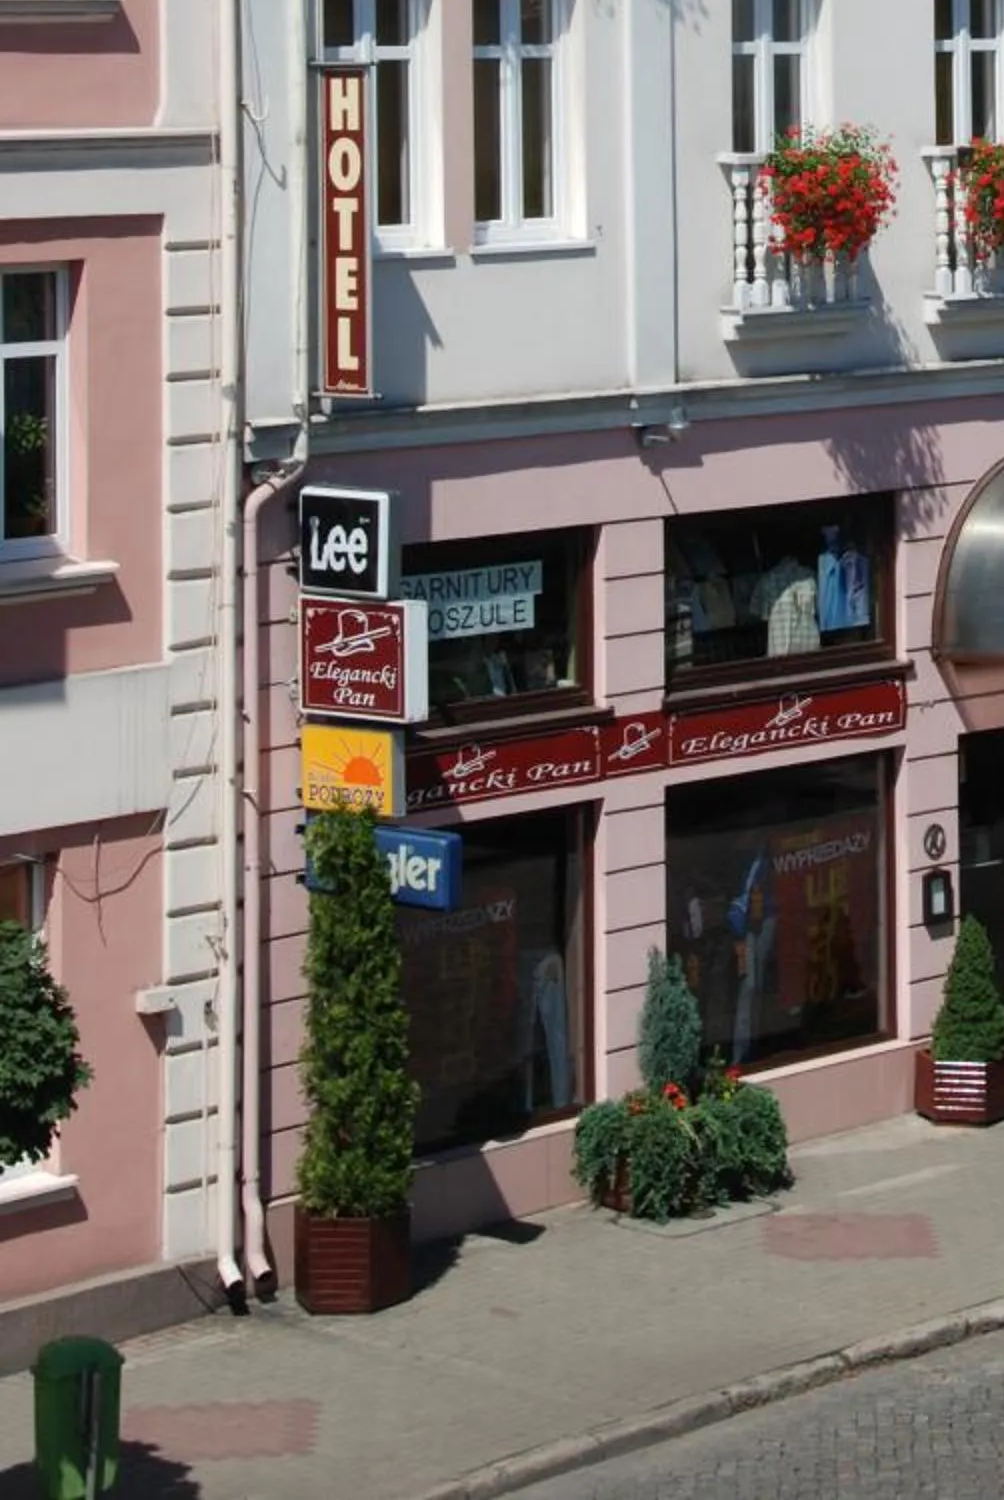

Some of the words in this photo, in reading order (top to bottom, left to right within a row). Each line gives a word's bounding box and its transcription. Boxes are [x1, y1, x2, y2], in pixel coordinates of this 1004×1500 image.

[328, 77, 361, 371] HOTEL
[309, 515, 369, 575] Lee
[400, 565, 535, 601] GARNITURY
[428, 599, 528, 635] OSZULE
[309, 660, 398, 690] Elegancki
[333, 687, 376, 707] Pan
[681, 715, 829, 755] Elegancki
[837, 710, 894, 729] Pan
[407, 767, 518, 805] gancki
[526, 760, 592, 781] Pan
